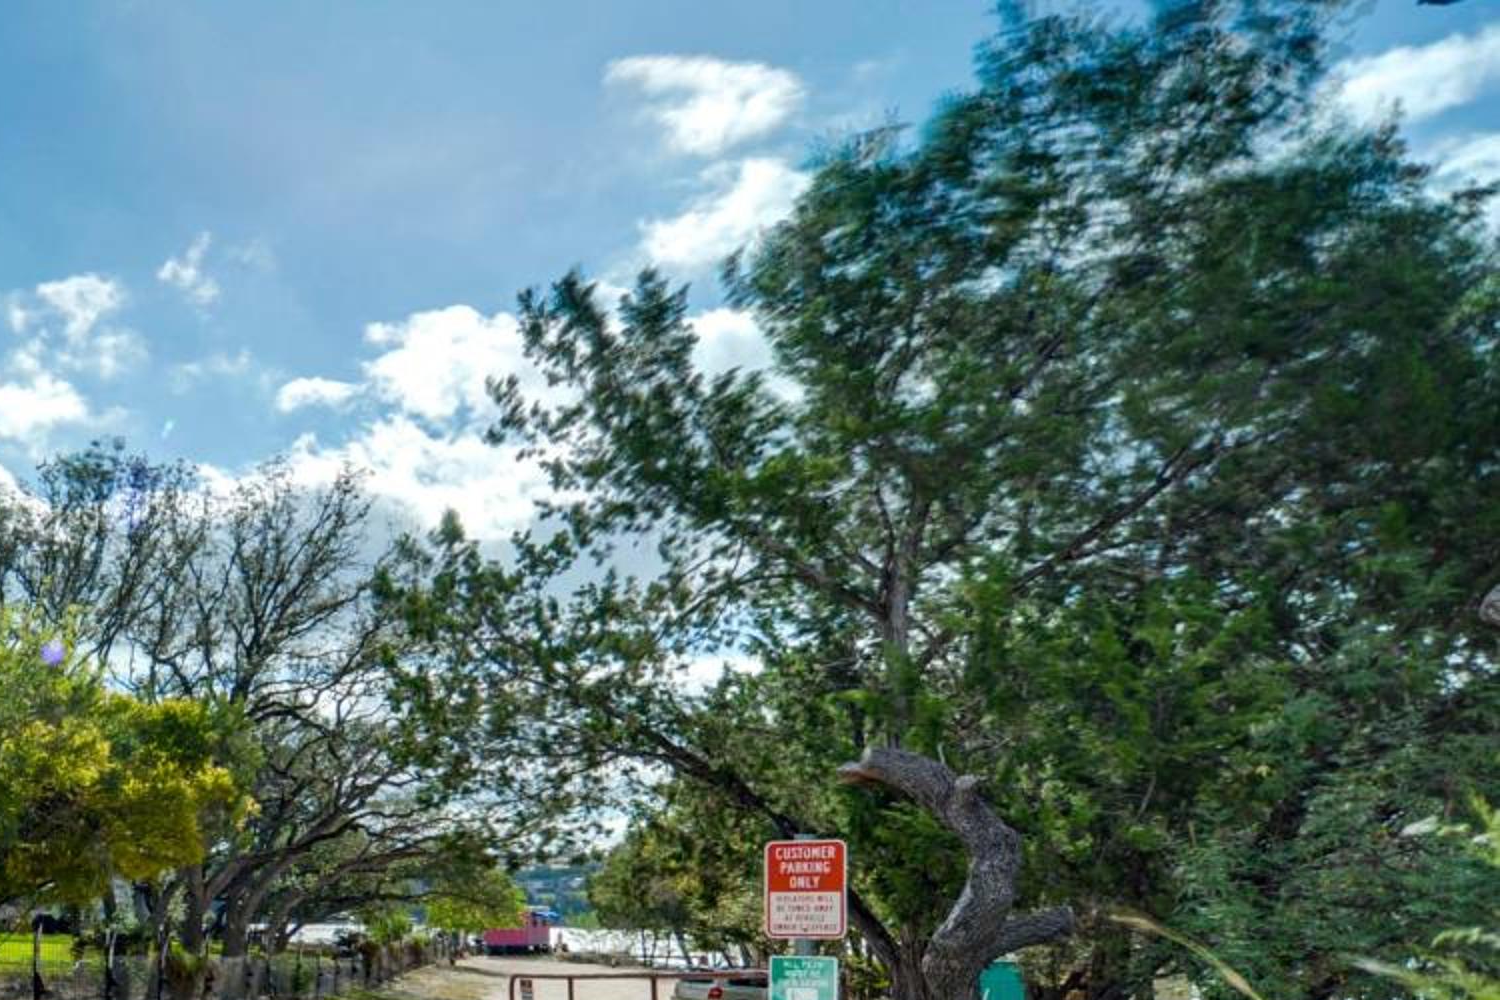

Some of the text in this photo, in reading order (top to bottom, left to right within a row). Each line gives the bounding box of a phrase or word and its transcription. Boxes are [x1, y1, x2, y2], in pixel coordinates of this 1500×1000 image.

[775, 846, 836, 860] CUSTOMER
[780, 861, 831, 875] PARKING
[789, 876, 820, 888] ONLY
